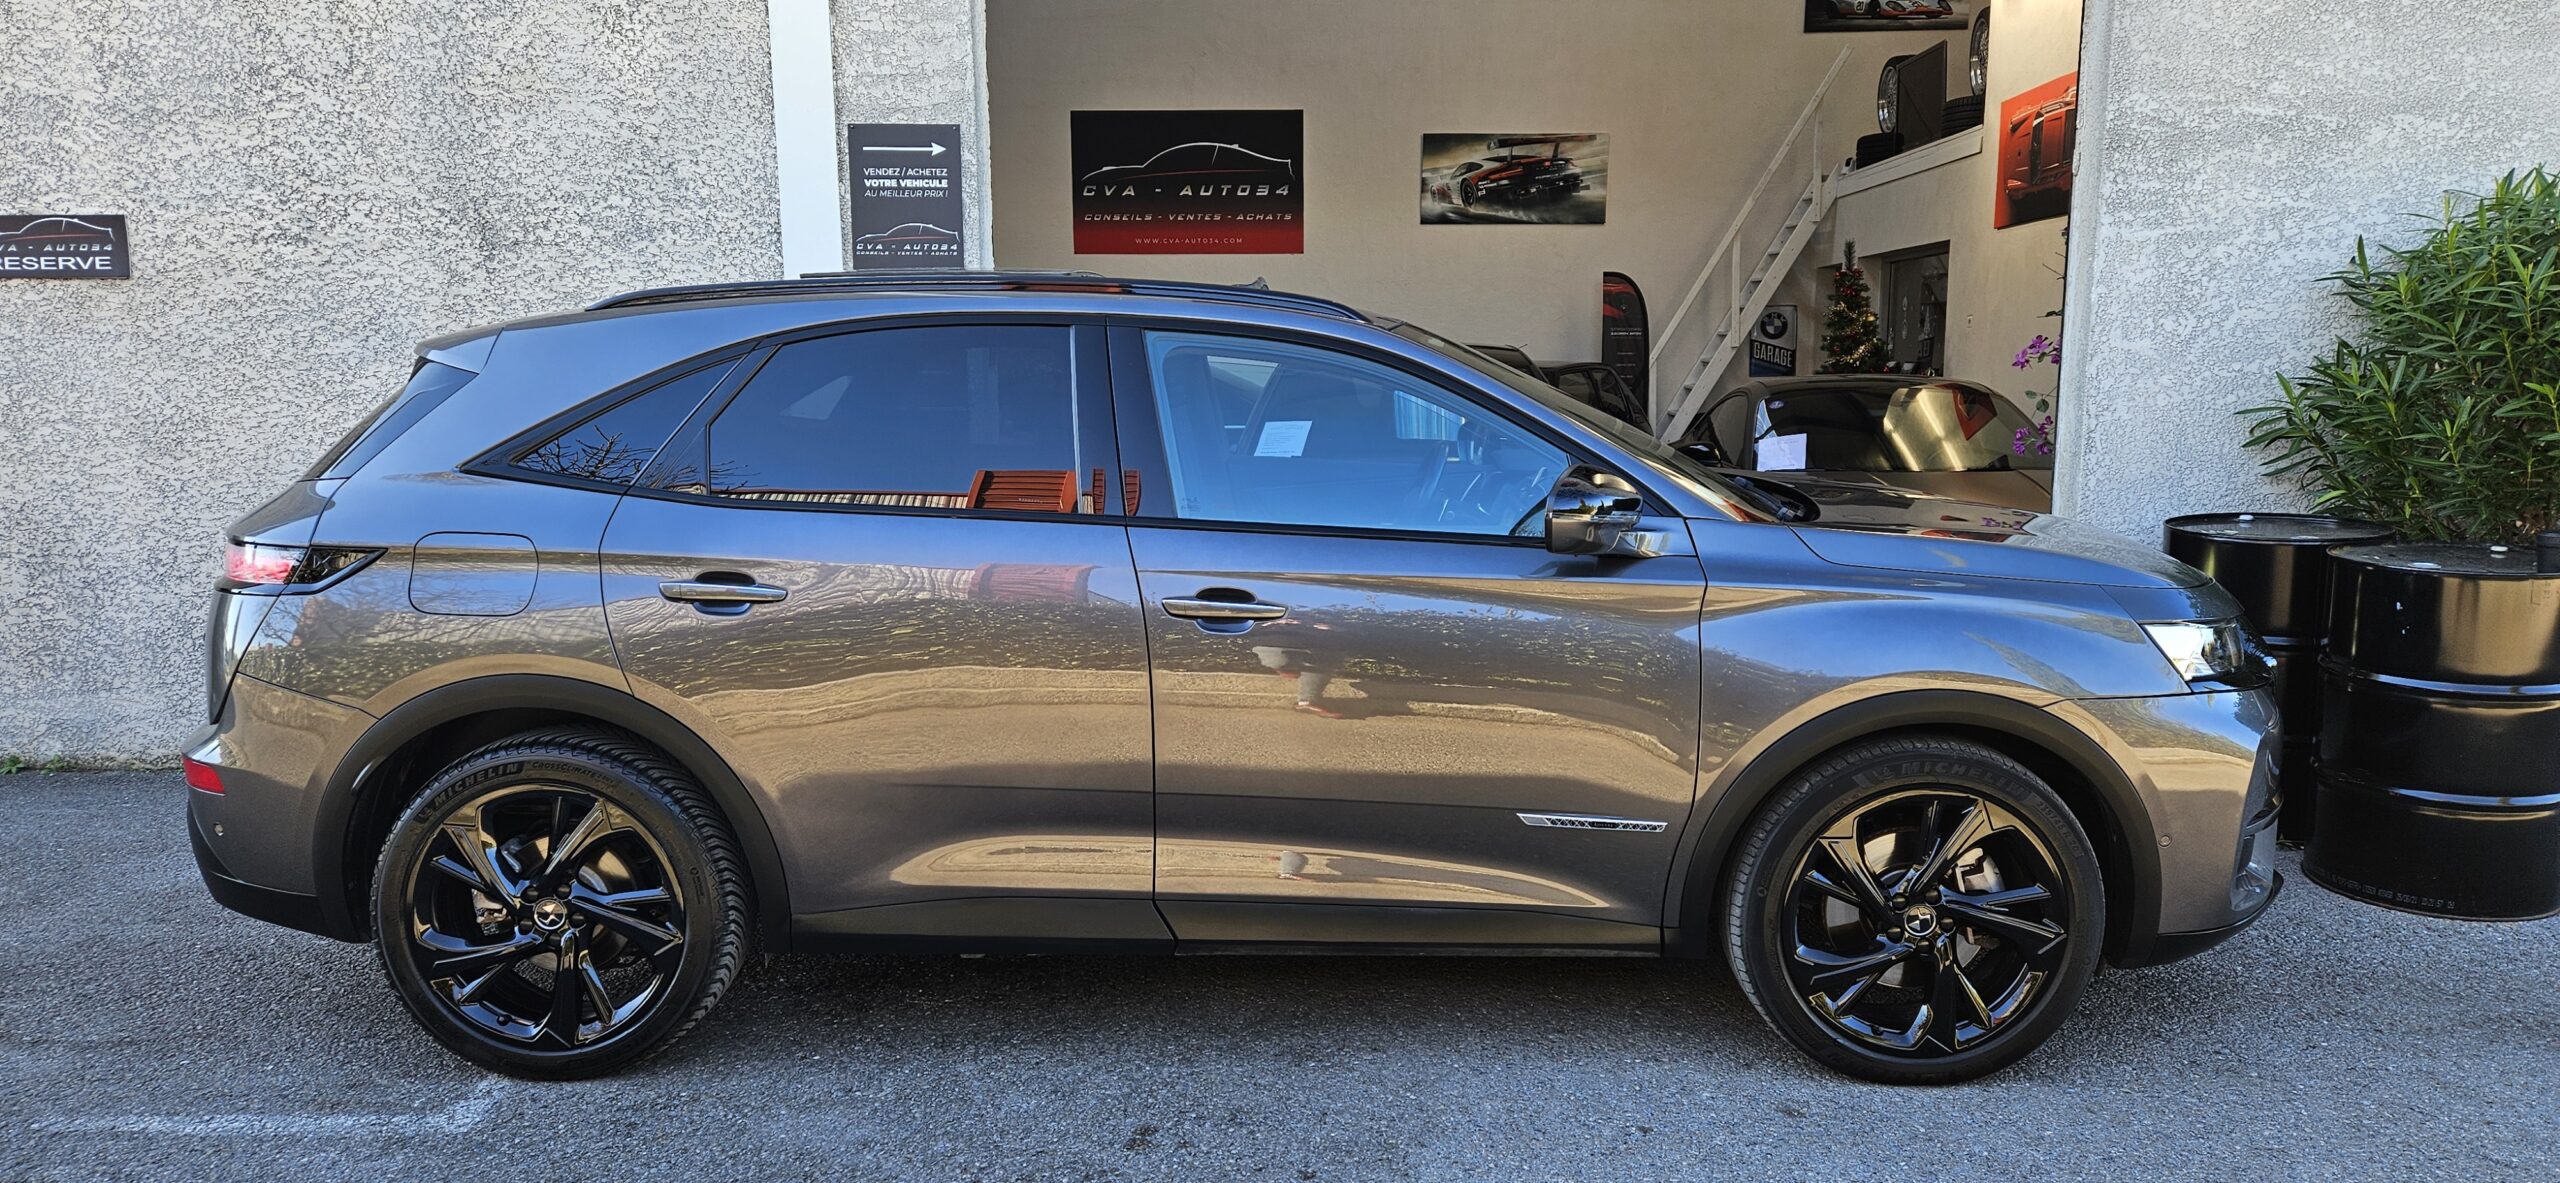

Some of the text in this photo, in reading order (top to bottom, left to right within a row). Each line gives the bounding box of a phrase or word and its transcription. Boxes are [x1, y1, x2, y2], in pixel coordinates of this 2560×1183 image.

[863, 167, 900, 176] VENDEZ
[907, 168, 948, 177] ACHETEZ
[864, 179, 949, 188] VOTRE VEHICULE
[864, 189, 878, 197] AU
[879, 189, 923, 198] MEILLEUR
[924, 190, 944, 198] PRIX
[1082, 185, 1136, 197] CVA
[1179, 185, 1290, 197] AUTO34
[1084, 213, 1153, 222] CONSEILS
[1168, 213, 1223, 221] VENTES
[1236, 213, 1293, 221] ACHATS
[1135, 237, 1243, 245] WWW.CVA-AUTO34.COM
[43, 243, 113, 252] AUTO34
[0, 256, 112, 271] ESERVE
[1753, 342, 1793, 368] GARAGE
[1901, 761, 2027, 797] MICHELIN
[434, 762, 519, 807] MICHELIN
